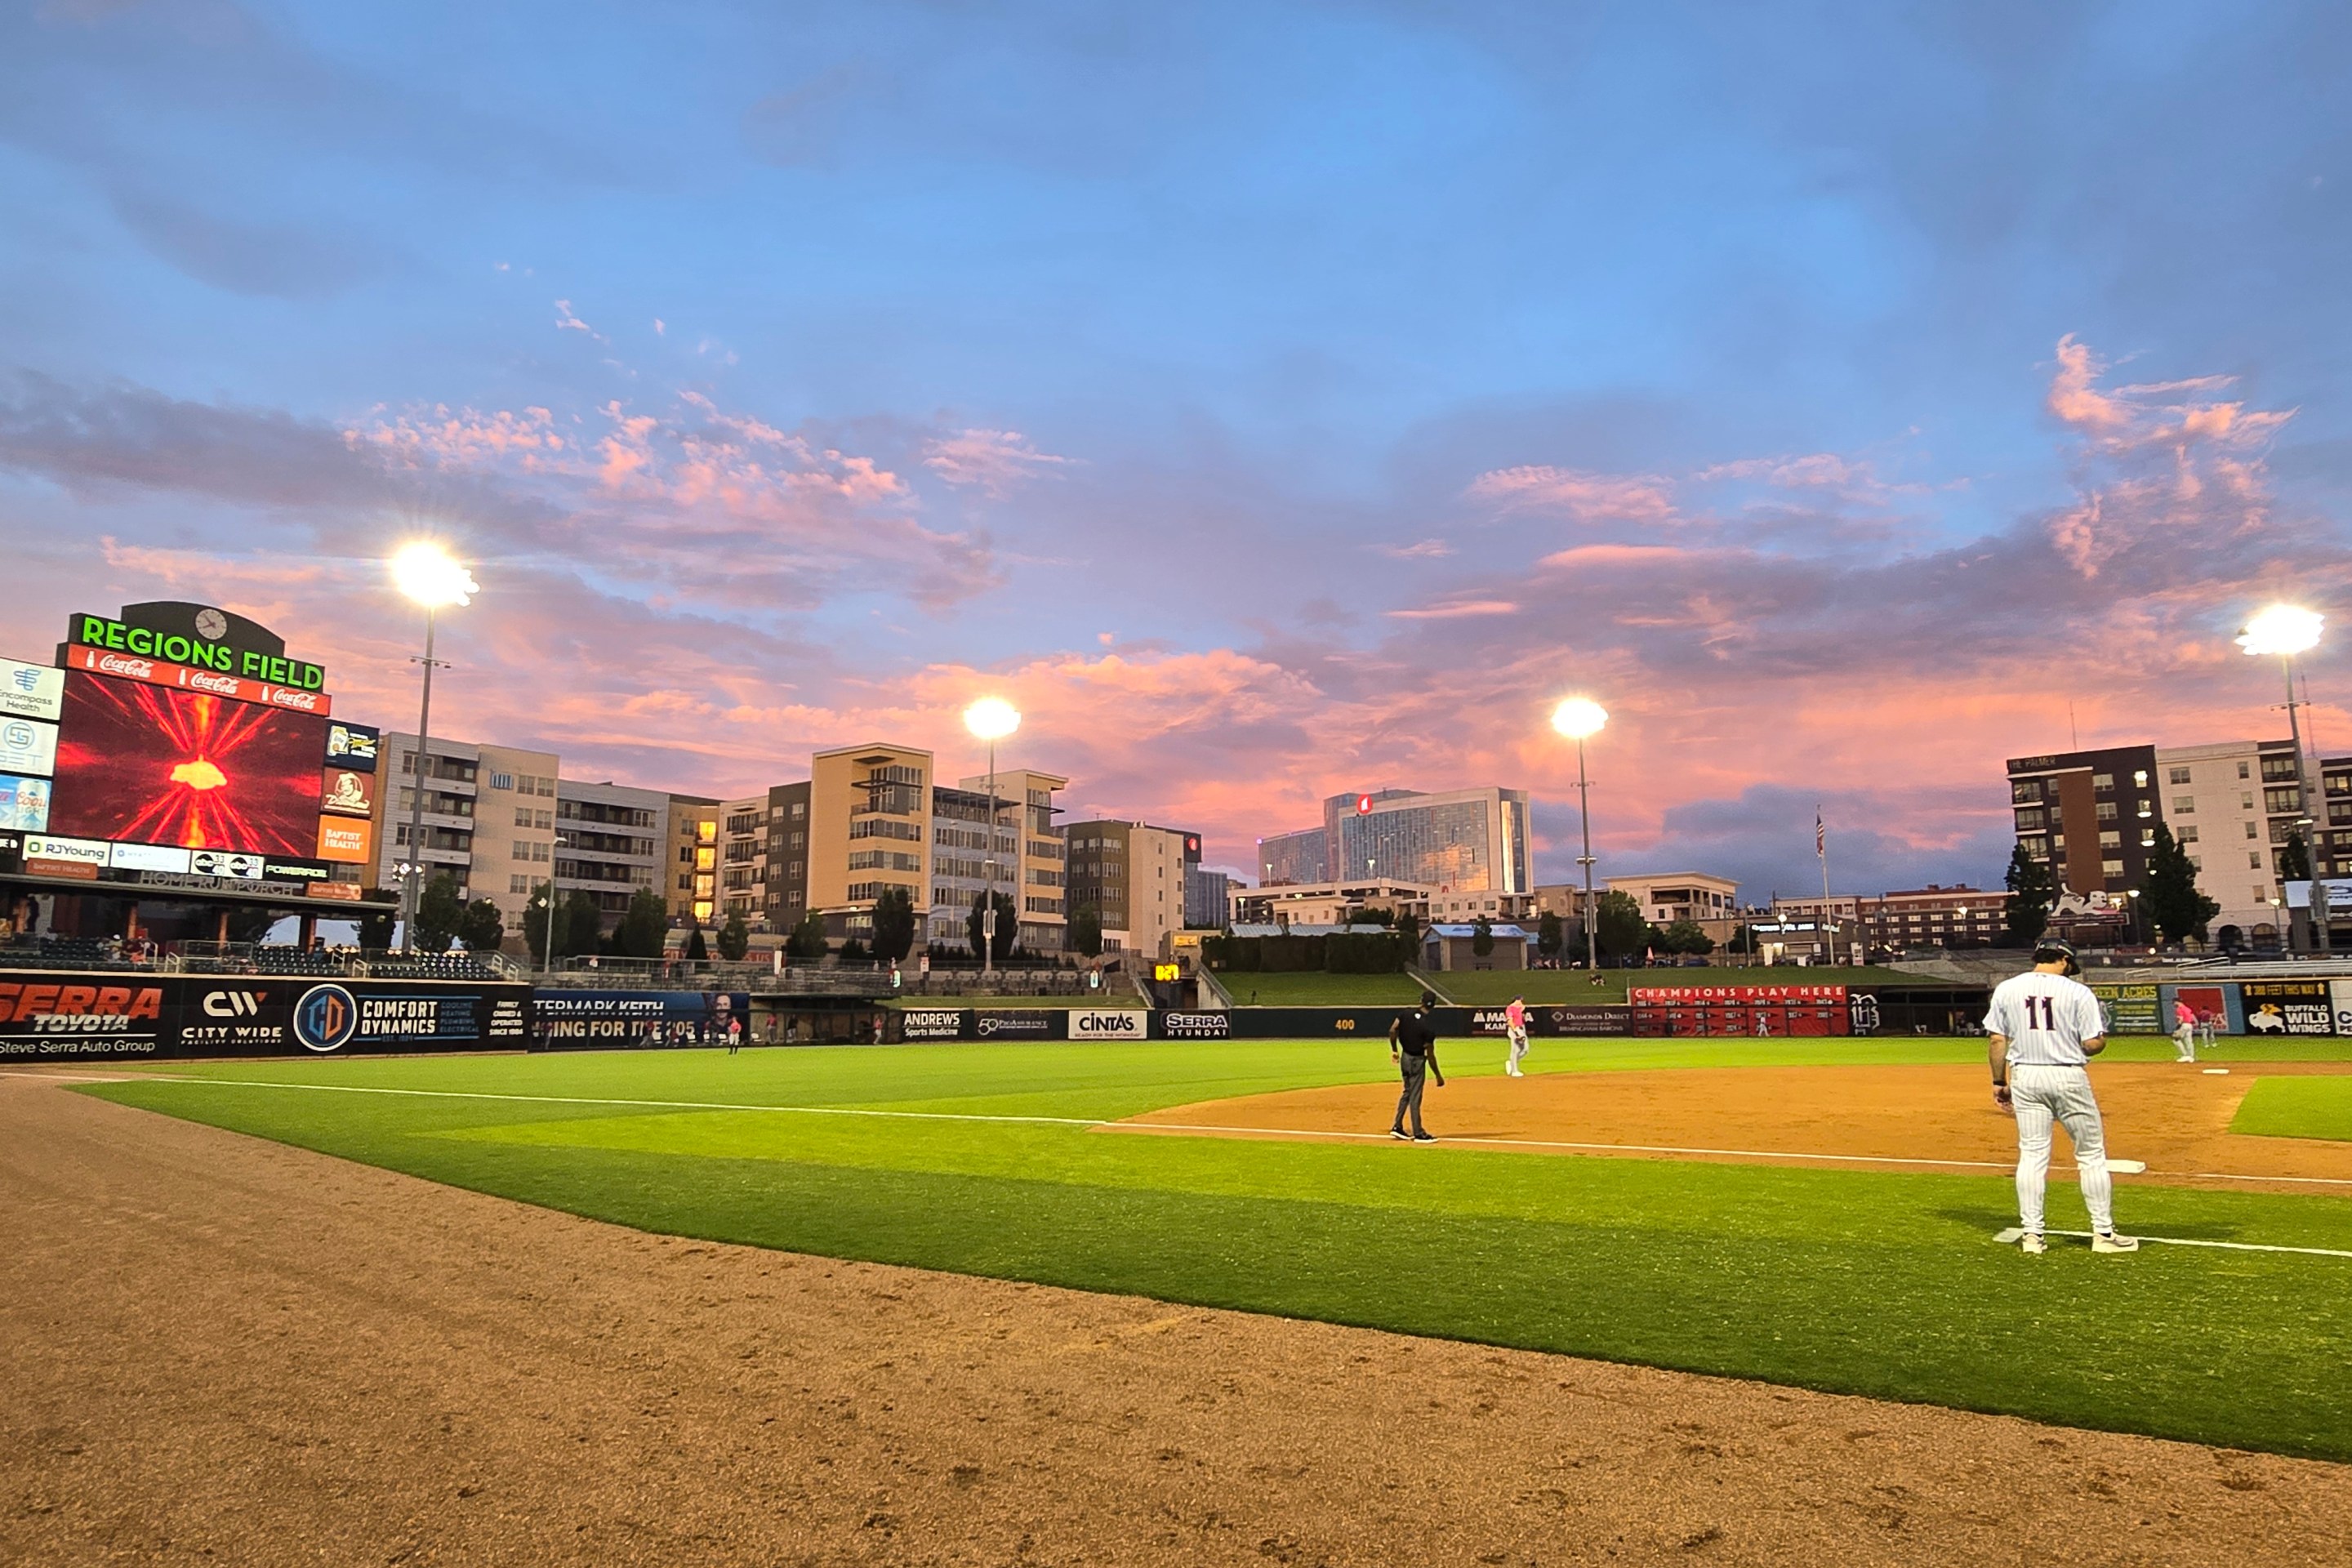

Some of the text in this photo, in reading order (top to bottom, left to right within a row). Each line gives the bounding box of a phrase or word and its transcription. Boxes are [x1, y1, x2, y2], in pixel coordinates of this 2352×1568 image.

[82, 617, 323, 688] REGIONS FIELD
[7, 700, 40, 712] Health
[2025, 756, 2056, 767] PALMER
[326, 829, 362, 841] BAPTIST
[325, 839, 360, 850] HEALTH
[139, 871, 194, 889] HOME
[198, 876, 234, 892] RUN
[237, 880, 294, 896] PORCH
[1635, 986, 1842, 998] CHAMPIONS PLAY HERE
[2123, 986, 2158, 998] ACRES
[0, 983, 163, 1022] SERRA
[363, 1000, 437, 1018] COMFORT
[904, 1013, 960, 1026] ANDREWS
[2025, 995, 2056, 1031] 11
[2284, 1012, 2330, 1024] WILD
[33, 1014, 130, 1031] TOYOTA
[361, 1019, 435, 1035] DYNAMICS
[1079, 1012, 1134, 1031] CINTAS
[1166, 1013, 1227, 1028] SERRA
[1335, 1019, 1355, 1030] 400
[181, 1027, 283, 1038] CITY WIDE
[590, 1021, 625, 1037] FOR
[905, 1027, 959, 1037] Sports Medicine
[2287, 1023, 2332, 1033] WINGS
[0, 1039, 156, 1054] Steve Serra Auto Group
